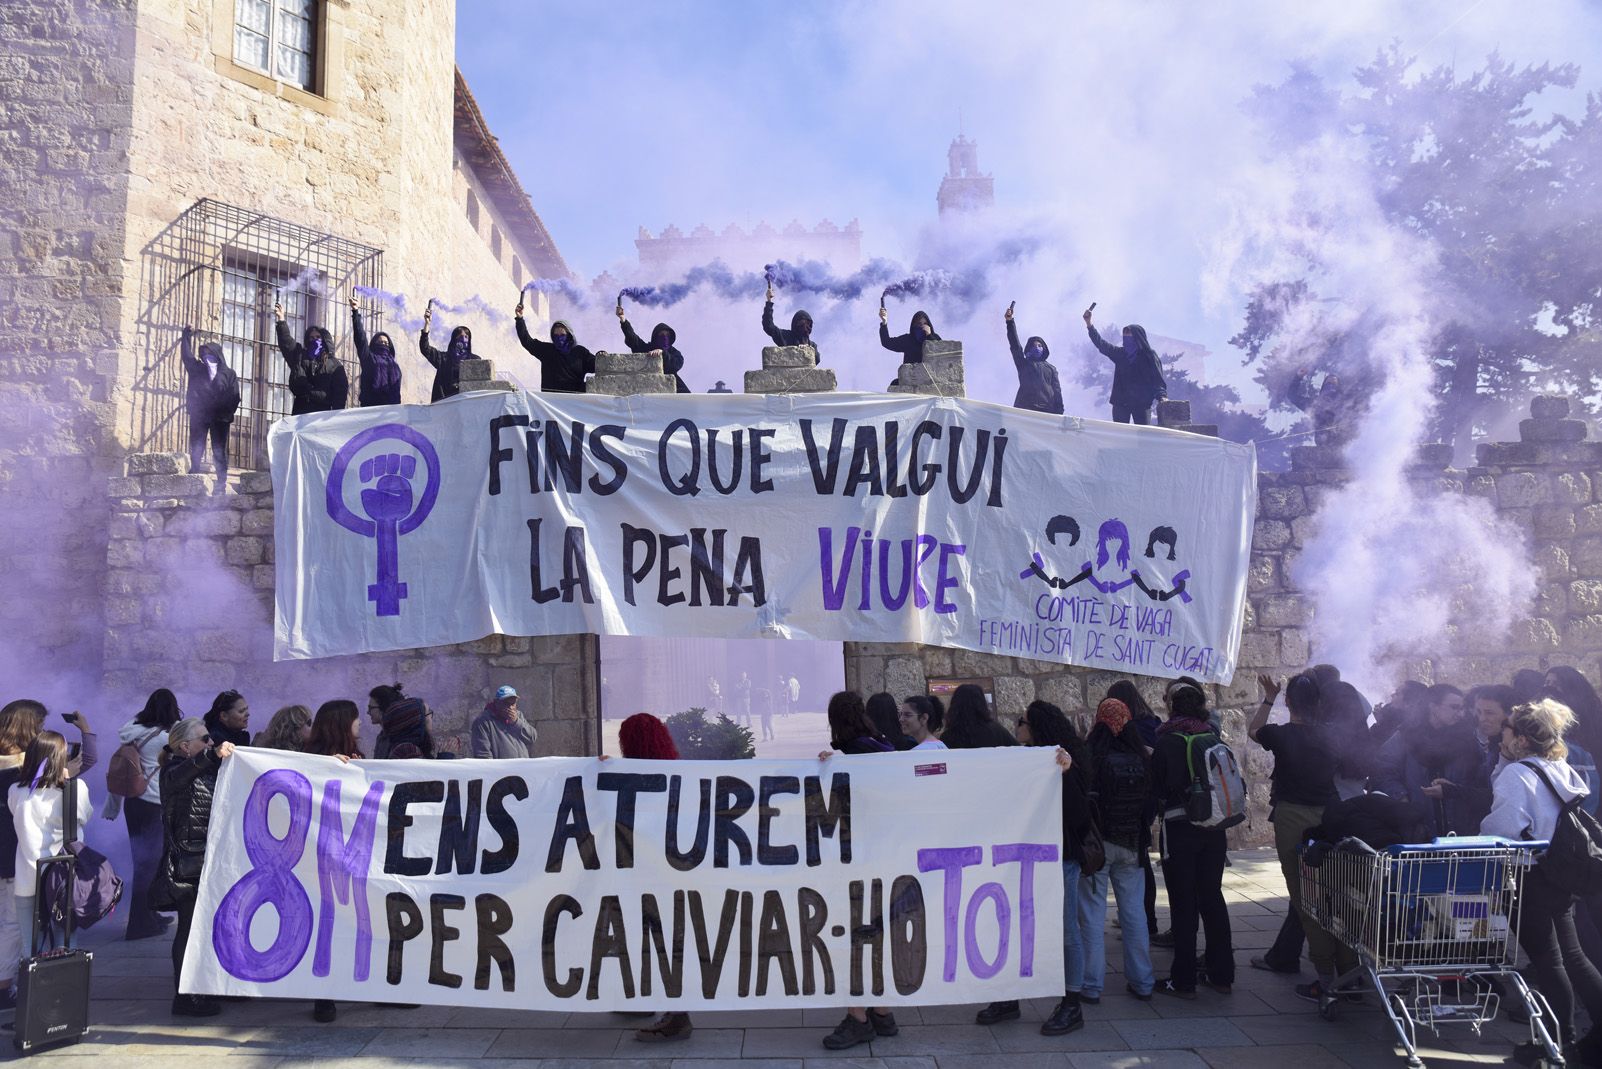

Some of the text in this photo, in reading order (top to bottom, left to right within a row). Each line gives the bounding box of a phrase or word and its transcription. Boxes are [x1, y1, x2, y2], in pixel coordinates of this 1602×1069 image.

[659, 418, 776, 497] QUE
[527, 518, 595, 604] LA
[621, 522, 766, 608] PENA
[1083, 630, 1106, 661] DE
[1111, 634, 1156, 665] SANT
[1162, 643, 1214, 675] CUGAT
[1109, 603, 1132, 630] DE
[1136, 606, 1172, 637] VAGA
[384, 772, 851, 876] ENS ATUREM
[212, 768, 385, 983] 8M
[385, 892, 515, 992] PER
[917, 843, 1059, 983] TOT
